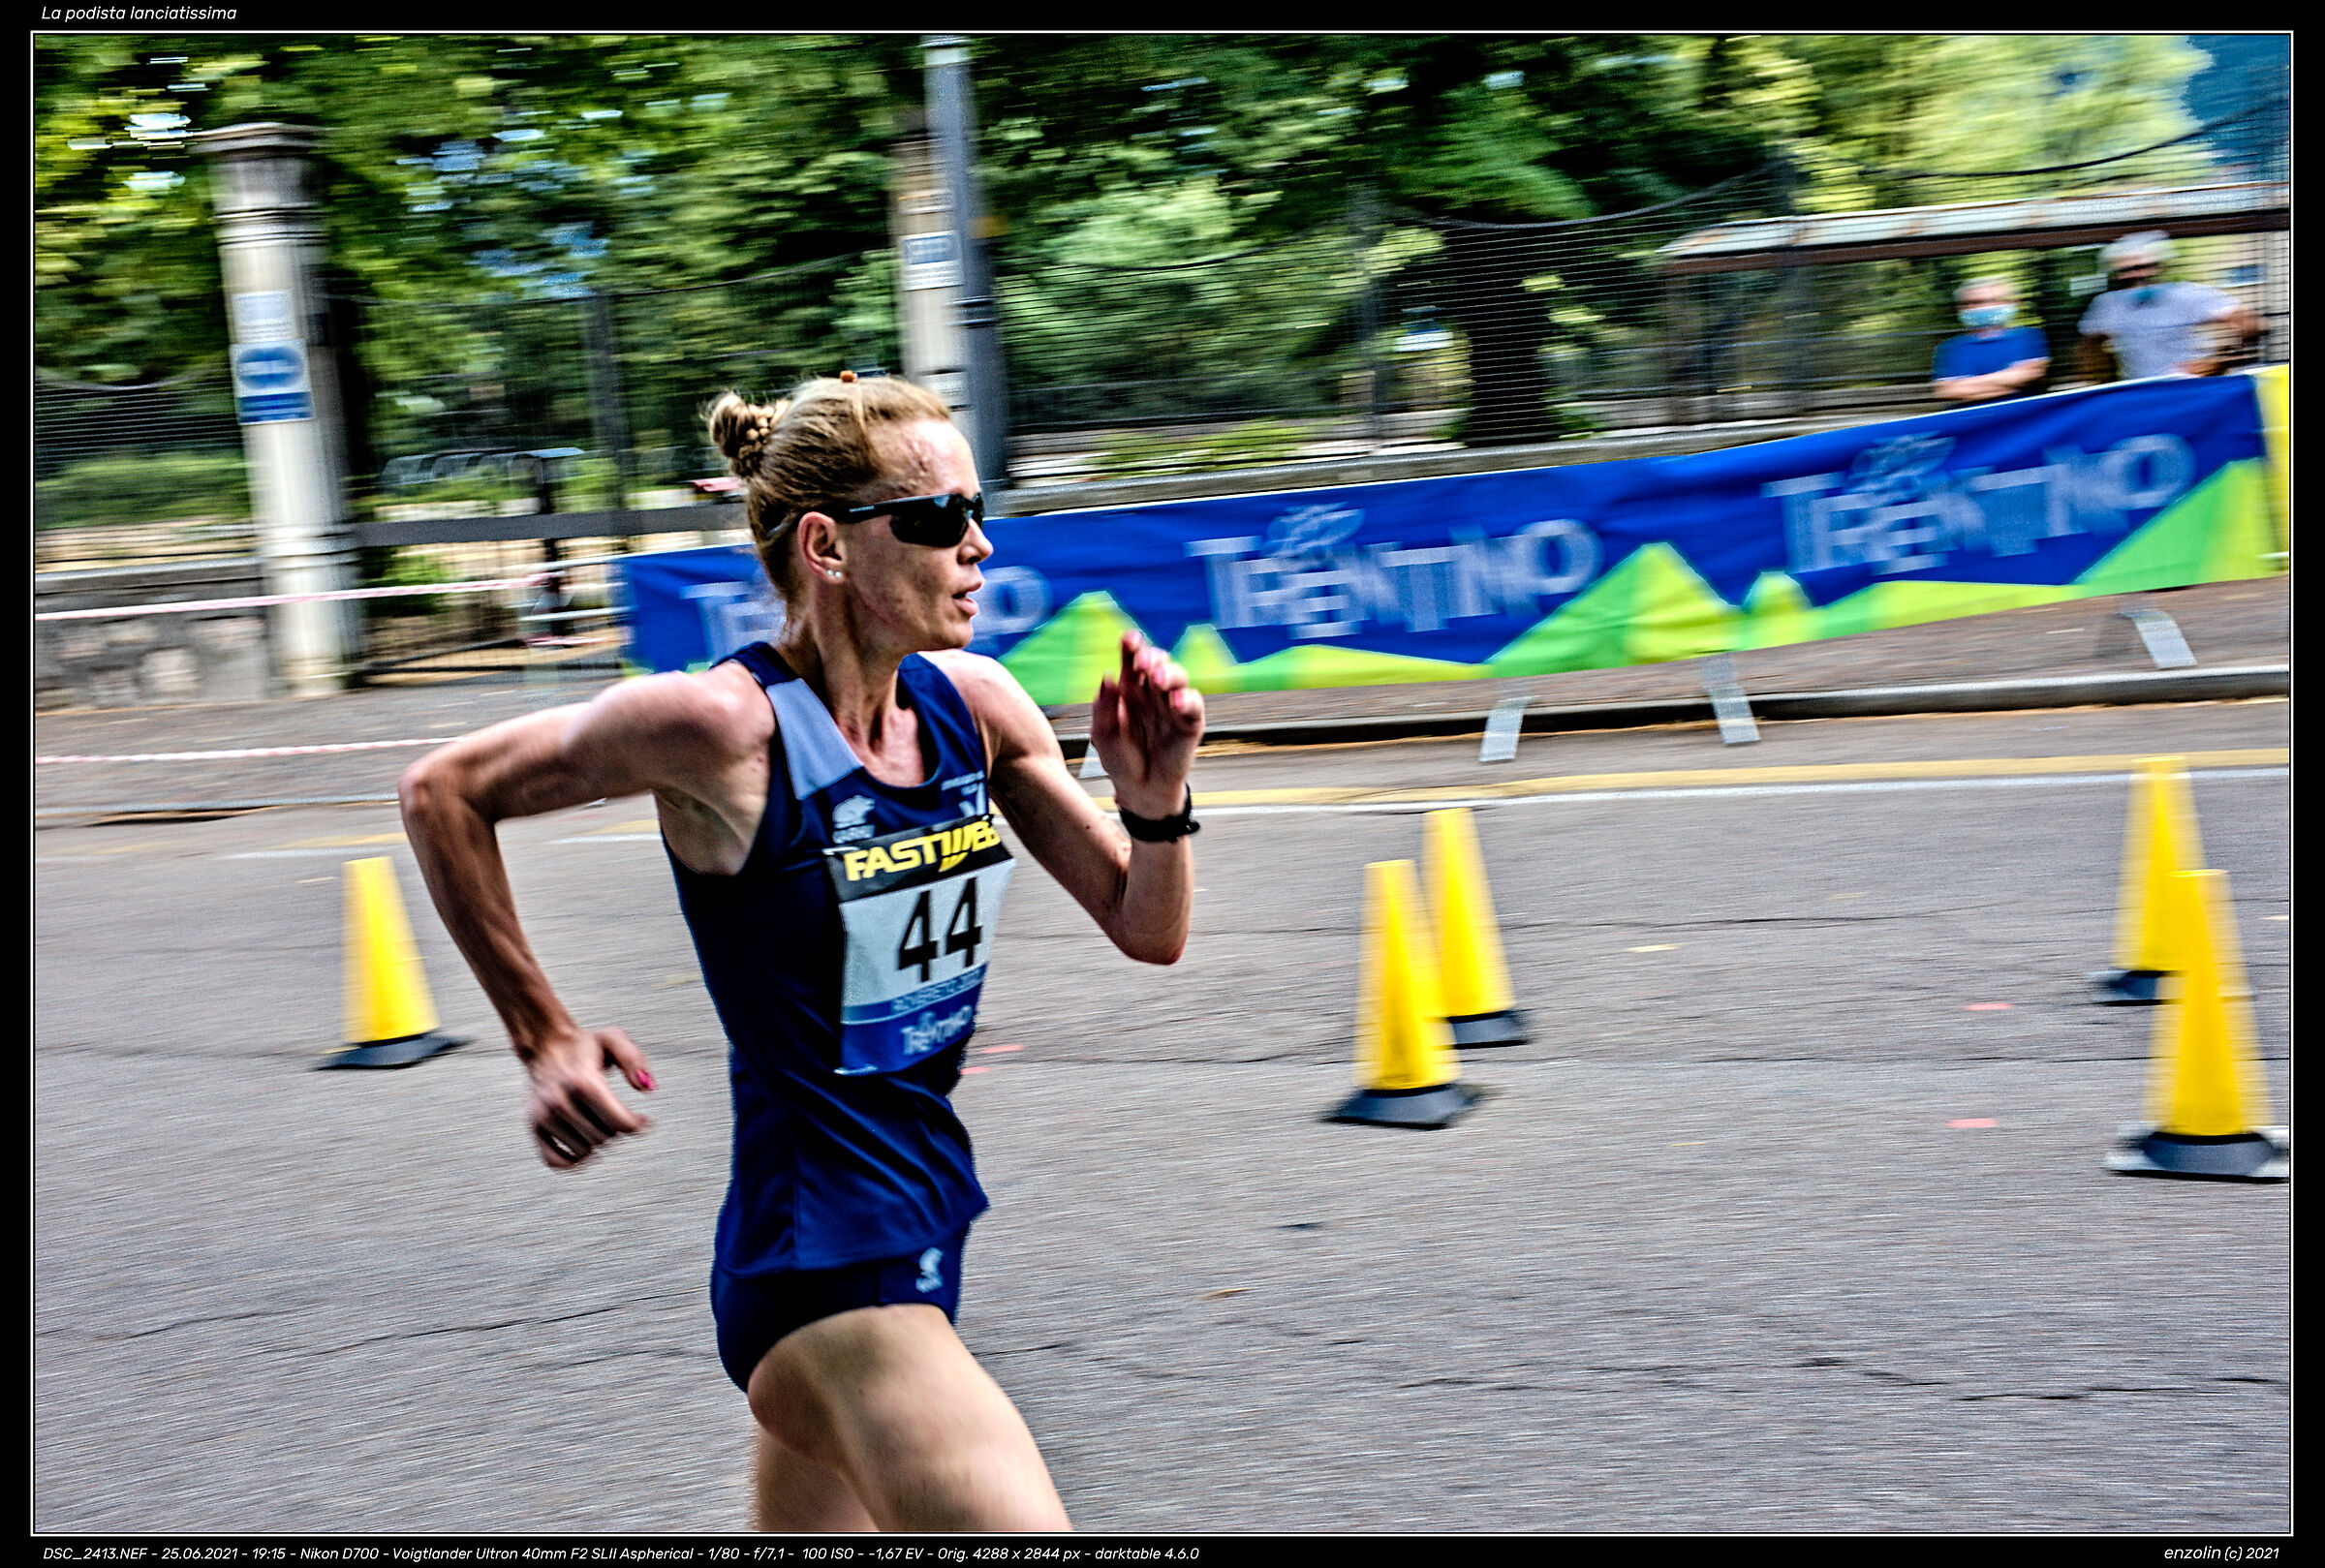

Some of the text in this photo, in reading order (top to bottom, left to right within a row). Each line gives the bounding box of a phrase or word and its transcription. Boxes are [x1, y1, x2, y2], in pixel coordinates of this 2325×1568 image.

[1763, 434, 2197, 574] TRENTINO
[1185, 518, 1603, 640] TRENTINO
[844, 820, 1002, 881] FASTWEB
[898, 877, 984, 983] 44
